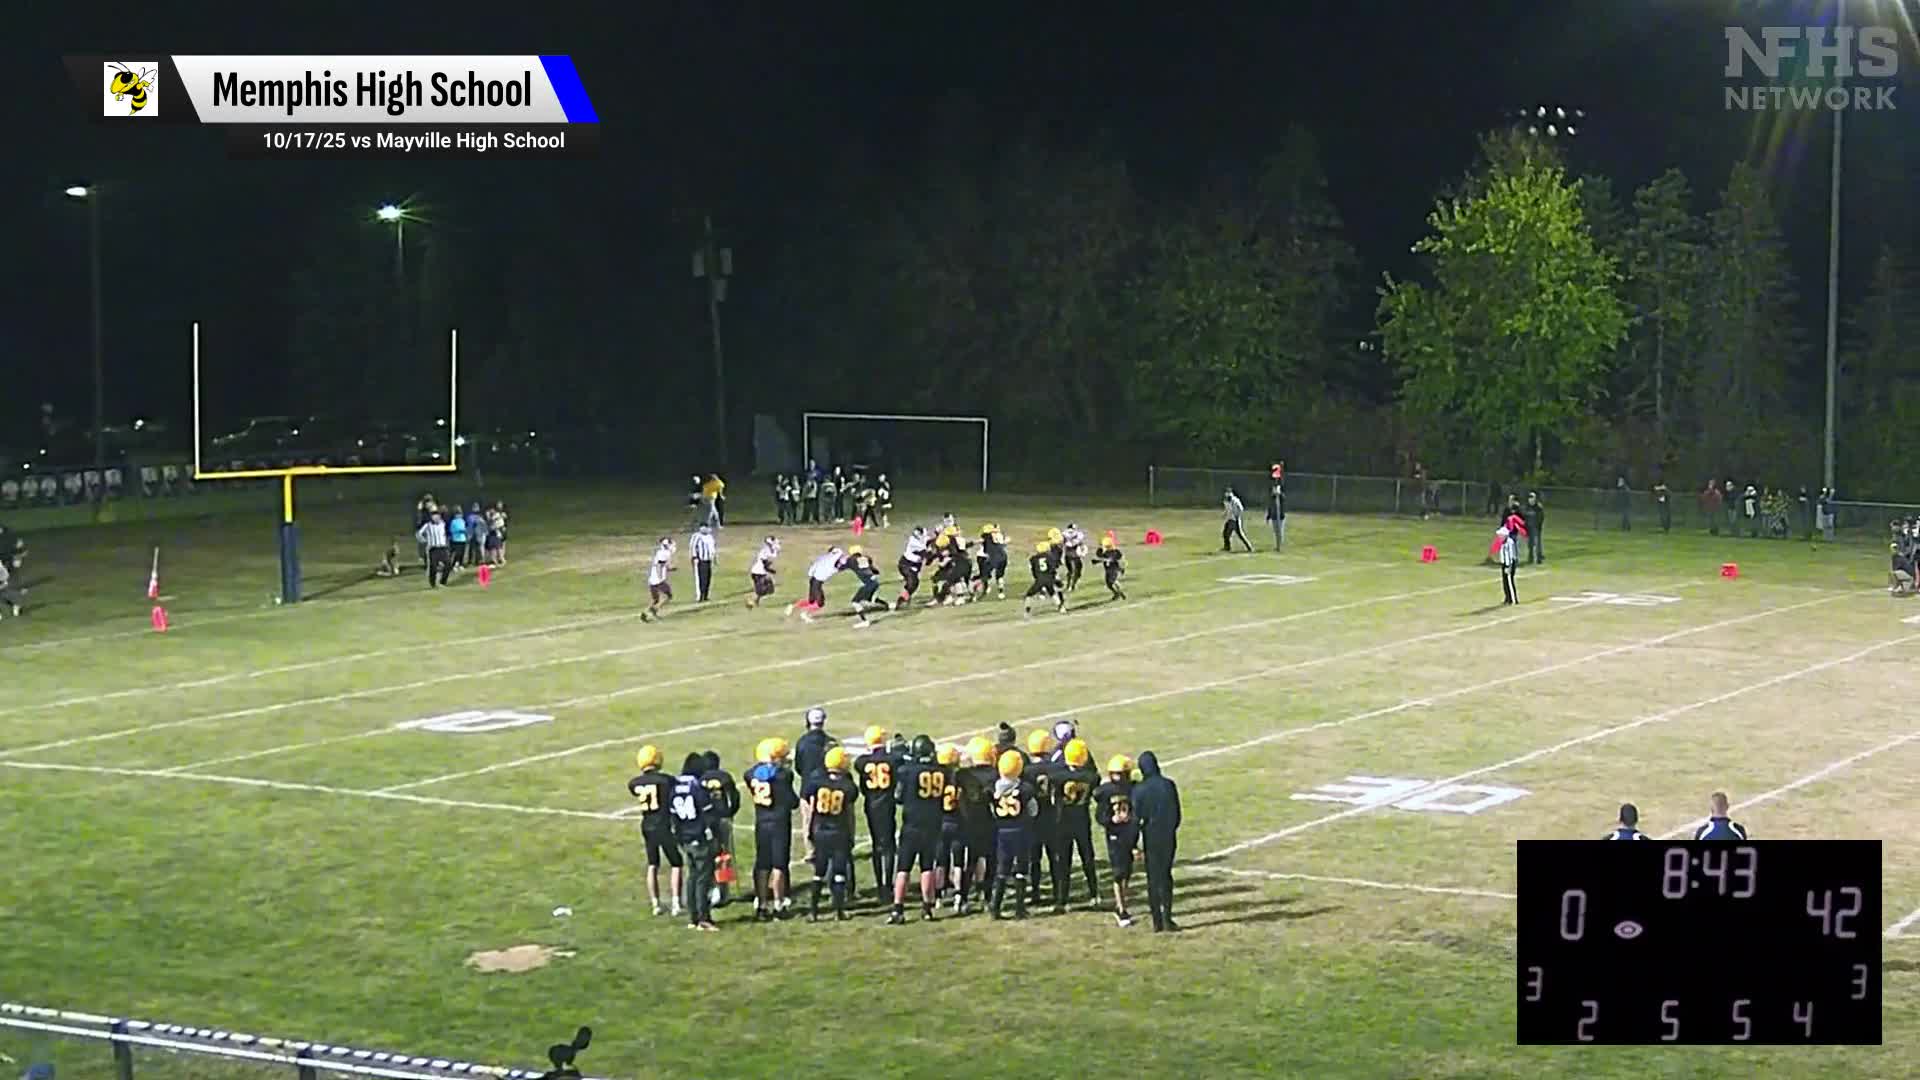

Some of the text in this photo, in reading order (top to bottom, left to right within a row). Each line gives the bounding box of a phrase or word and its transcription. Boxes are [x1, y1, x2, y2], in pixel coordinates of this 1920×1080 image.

[864, 762, 891, 789] 36
[919, 771, 944, 798] 99
[816, 787, 845, 815] 88
[1289, 772, 1534, 815] 30
